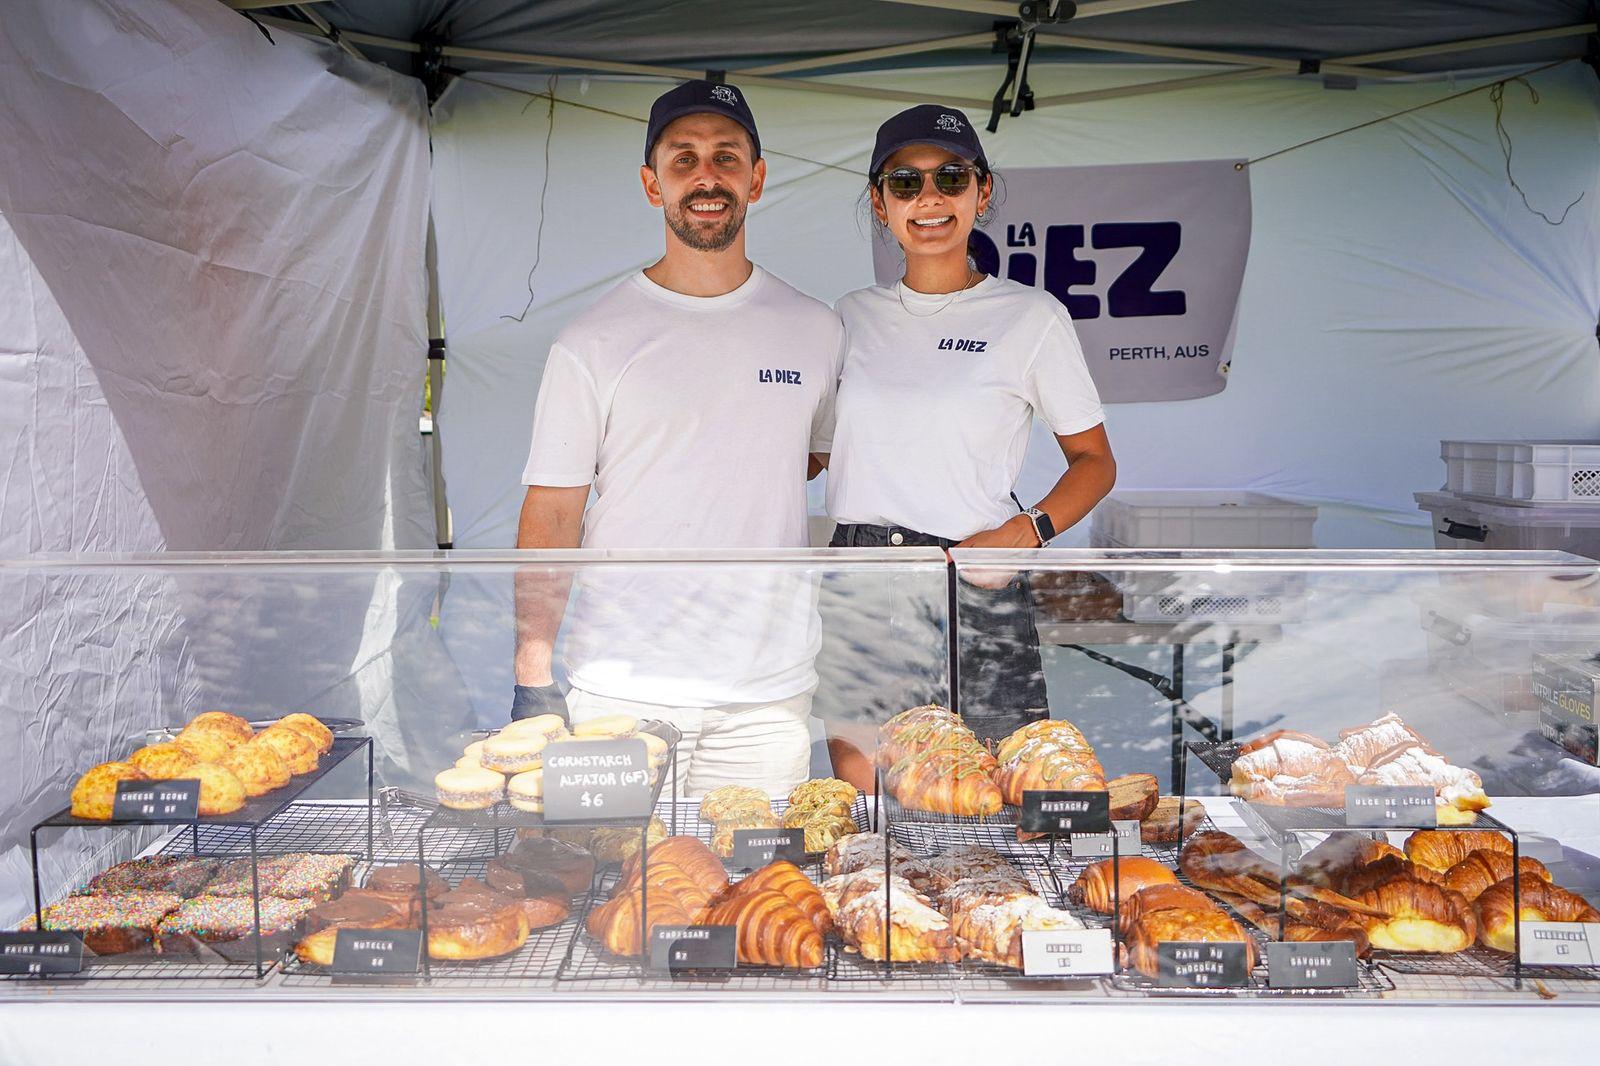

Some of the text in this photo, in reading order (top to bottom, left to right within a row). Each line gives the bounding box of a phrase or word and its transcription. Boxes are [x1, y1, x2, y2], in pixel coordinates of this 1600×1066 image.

[1007, 222, 1036, 247] LA
[938, 338, 988, 352] LA DIEZ
[1109, 345, 1209, 361] PERTH, AUS
[759, 369, 802, 385] LA DIEZ
[1532, 681, 1559, 705] NITRILE
[1559, 694, 1591, 720] GLOVES
[548, 754, 633, 768] CORNSTARCH
[560, 772, 617, 787] ALFAJOR
[121, 792, 188, 801] CHEESE SCONE
[581, 791, 603, 807] $6
[1041, 801, 1090, 812] PISTACHO
[748, 838, 791, 847] PISTACHIO
[659, 930, 710, 940] CROISSANT
[4, 944, 70, 955] FAIRY BREAD
[353, 941, 394, 951] NUTELLA
[1176, 947, 1223, 960] PAIN AU
[1176, 962, 1224, 975] CHOCOLAT
[1290, 957, 1332, 967] SAVOURY
